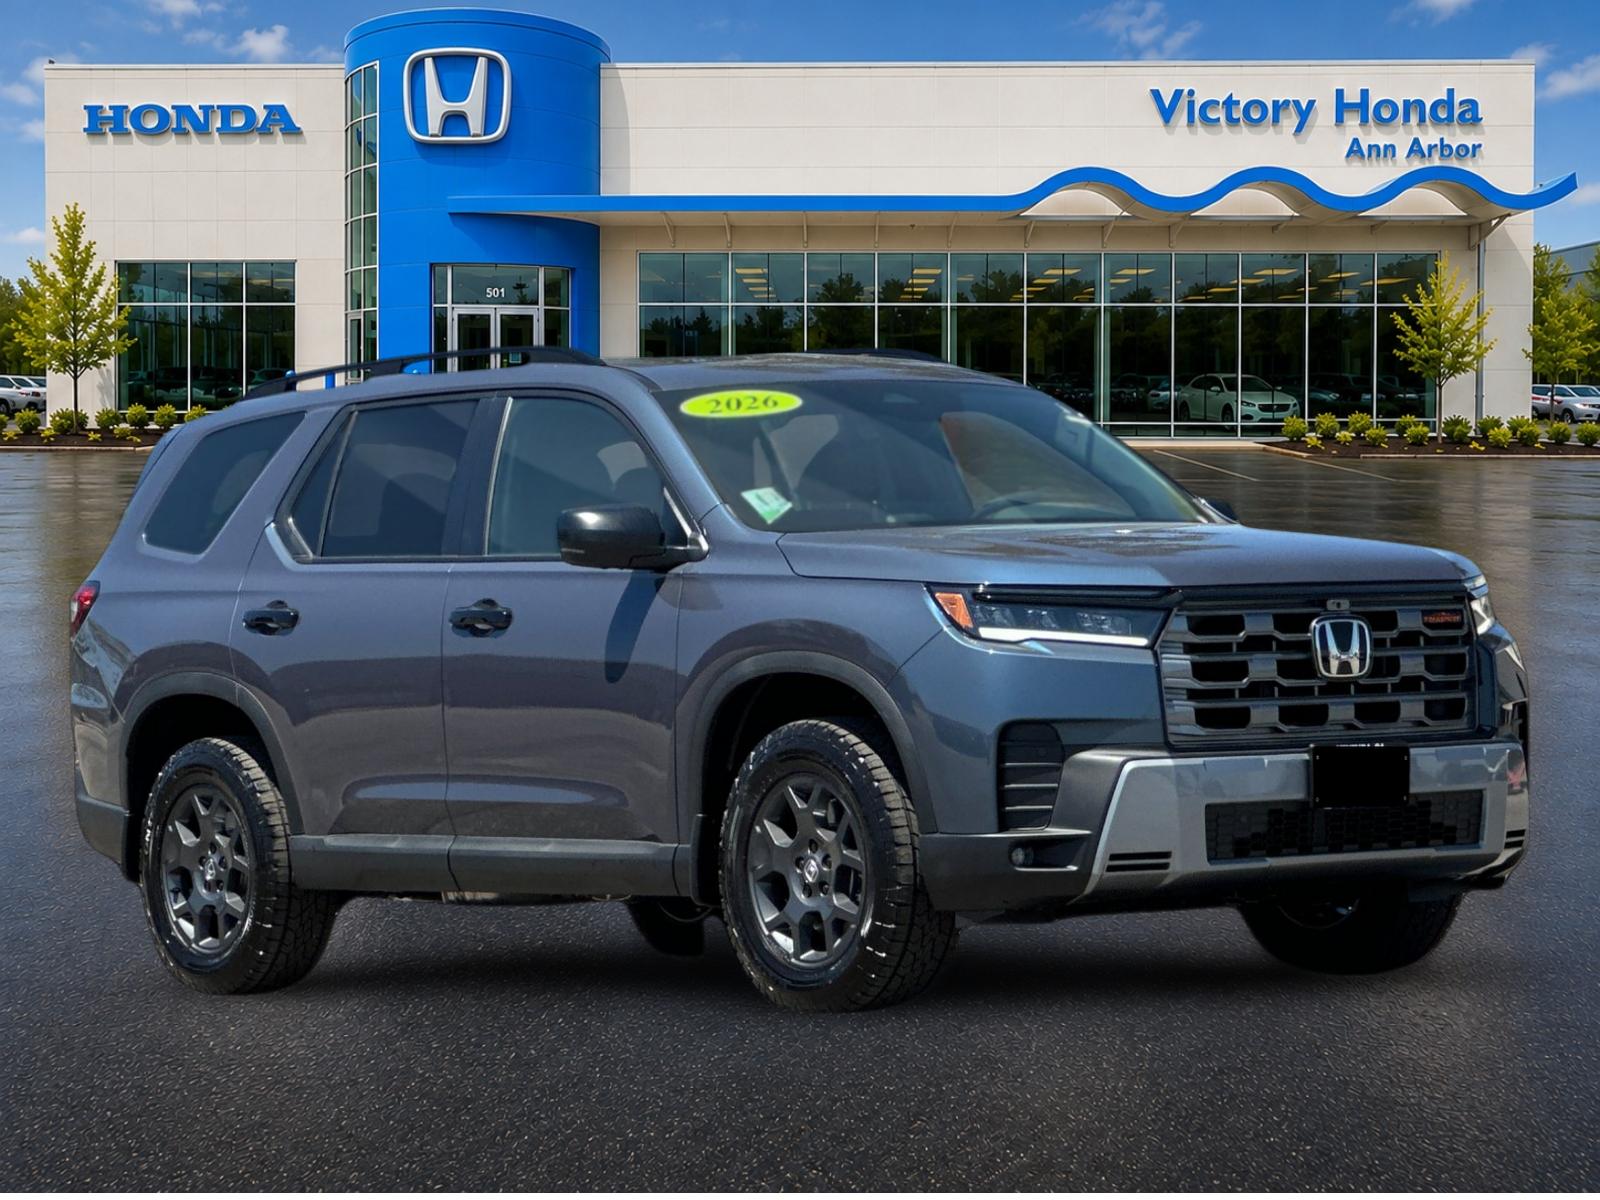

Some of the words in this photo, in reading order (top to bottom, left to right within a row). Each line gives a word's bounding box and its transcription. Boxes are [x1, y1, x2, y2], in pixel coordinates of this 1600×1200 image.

[83, 104, 301, 135] HONDA
[1151, 88, 1316, 135] Victory
[1335, 87, 1483, 125] Honda
[1345, 137, 1397, 159] Ann
[1405, 137, 1483, 159] Arbor
[486, 287, 505, 298] 501
[708, 395, 779, 413] 2026
